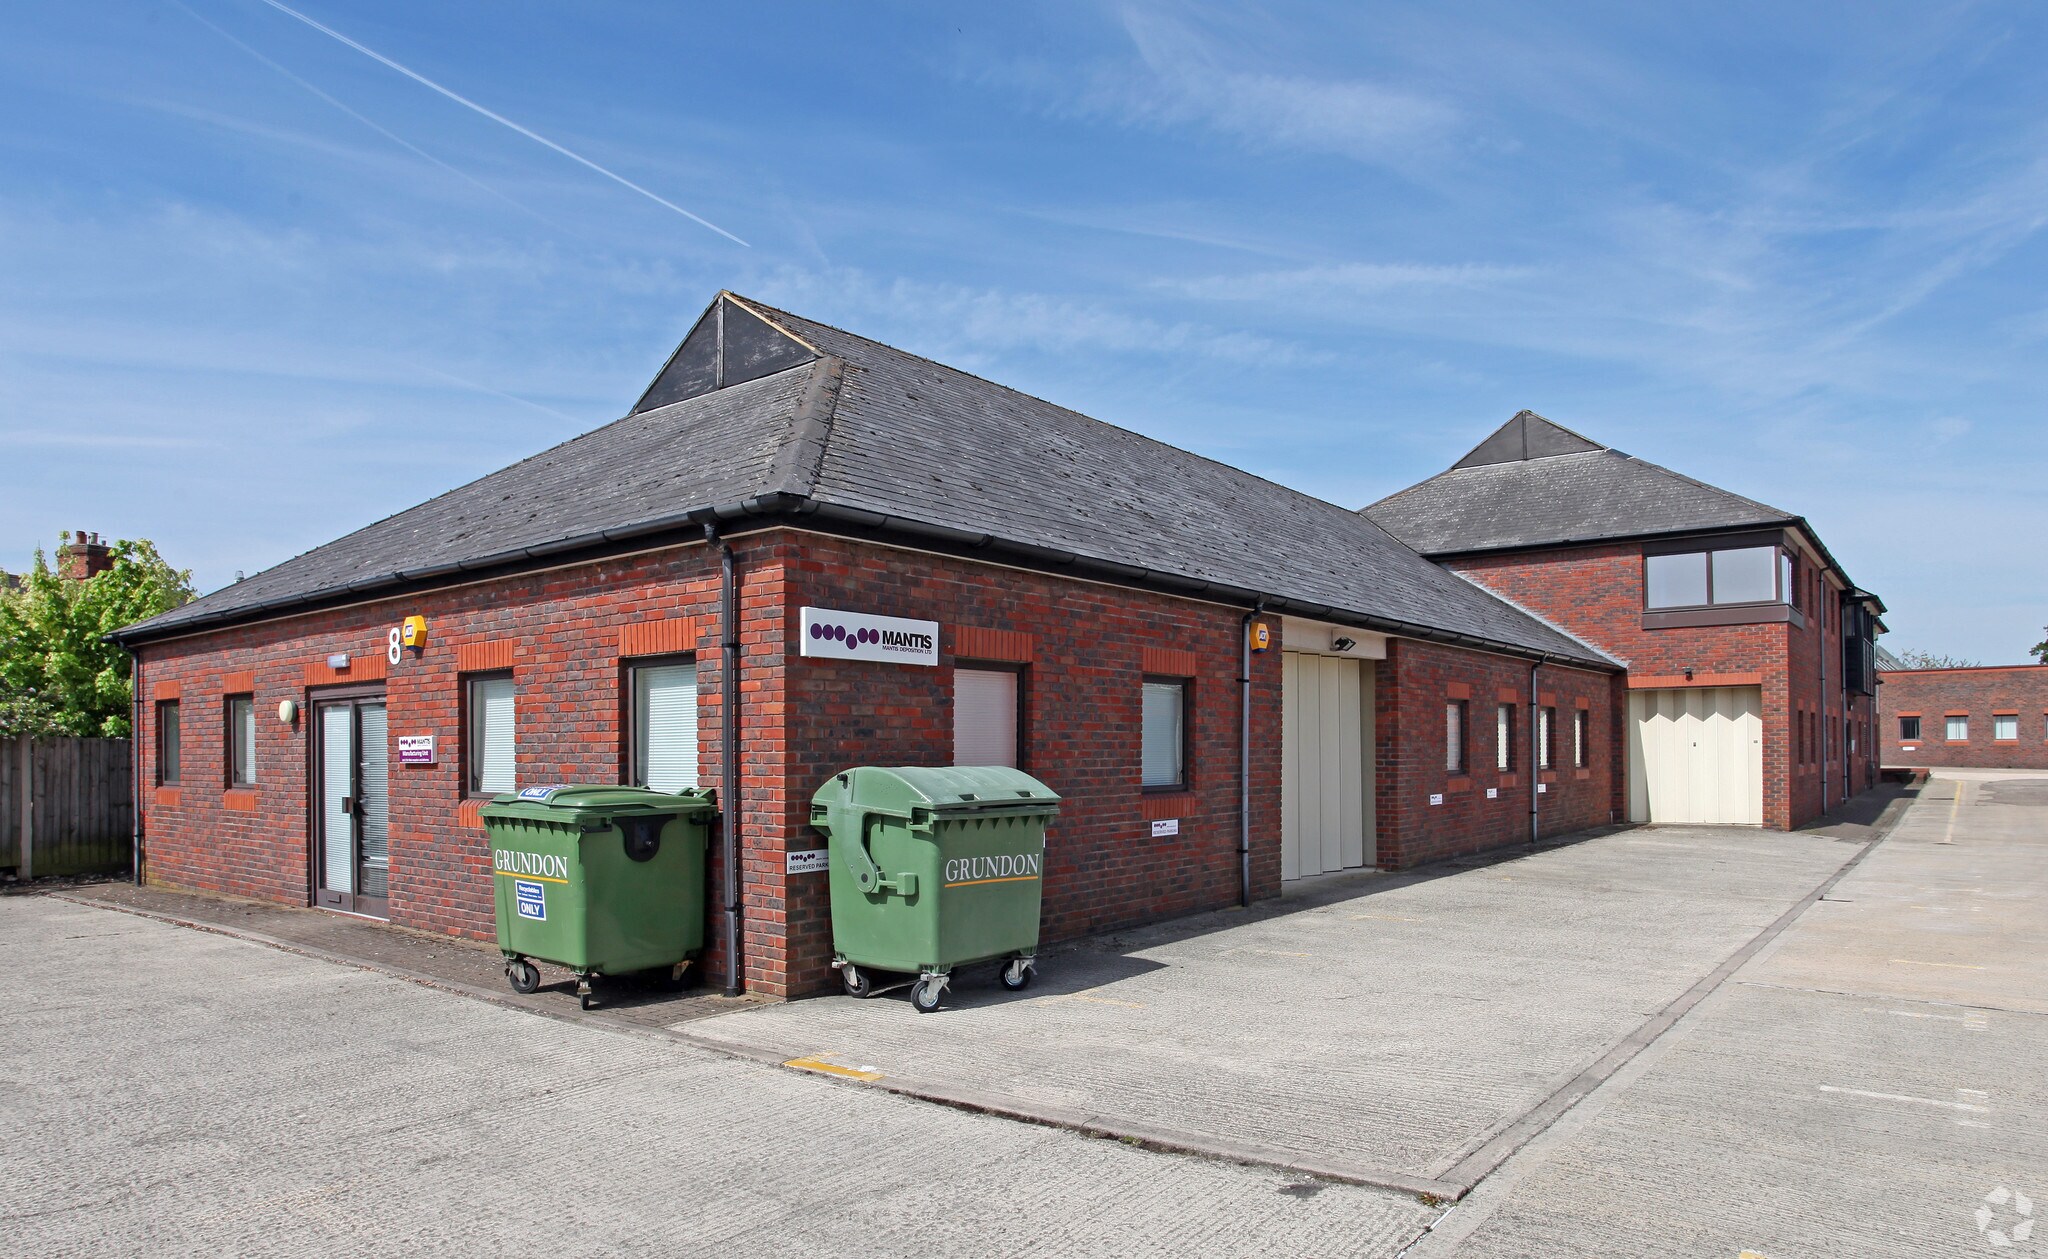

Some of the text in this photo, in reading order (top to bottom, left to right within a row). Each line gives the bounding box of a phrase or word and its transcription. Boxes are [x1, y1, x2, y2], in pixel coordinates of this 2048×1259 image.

[389, 627, 401, 665] 8
[882, 630, 933, 649] MANTIS
[525, 787, 547, 796] ONLY
[495, 849, 568, 879] GRUNDON
[789, 864, 815, 872] RESERVED
[945, 853, 1040, 881] GRUNDON
[520, 902, 540, 916] ONLY
